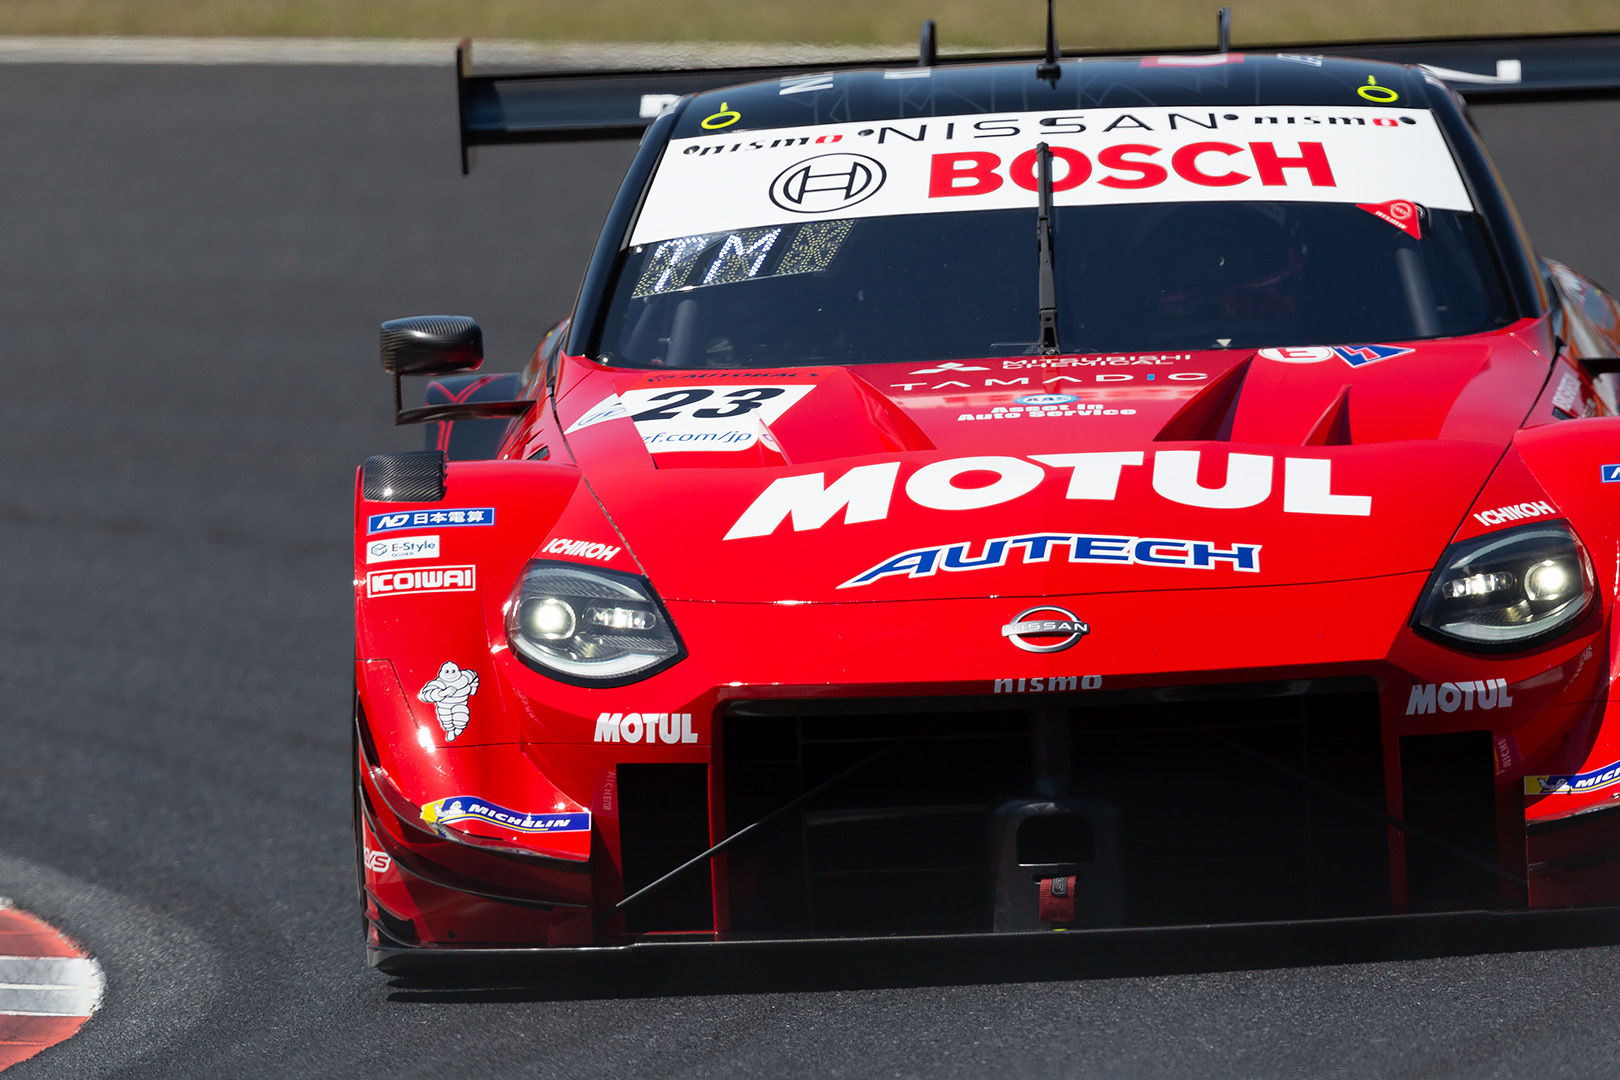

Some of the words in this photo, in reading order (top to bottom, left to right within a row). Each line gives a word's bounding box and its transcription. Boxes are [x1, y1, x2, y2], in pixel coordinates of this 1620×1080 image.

[700, 134, 843, 156] nismo
[877, 111, 1217, 145] NISSAN
[1253, 114, 1399, 128] nismo
[928, 141, 1337, 198] BOSCH
[890, 372, 1208, 391] TAMADIC
[632, 387, 786, 423] 23
[957, 412, 1021, 421] Auto
[1028, 409, 1137, 418] Service
[722, 450, 1373, 541] MOTUL
[413, 510, 485, 525] 日本電算
[1473, 500, 1556, 527] ICHIKOH
[392, 540, 436, 552] E-Style
[541, 538, 621, 561] ICHIKOH
[836, 532, 1263, 590] AUTECH
[371, 570, 472, 593] KOIWAI
[1004, 621, 1088, 632] NISSAN
[994, 675, 1103, 693] nismo
[1405, 678, 1513, 716] MOTUL
[594, 712, 698, 744] MOTUL
[468, 803, 570, 828] MICHELIN
